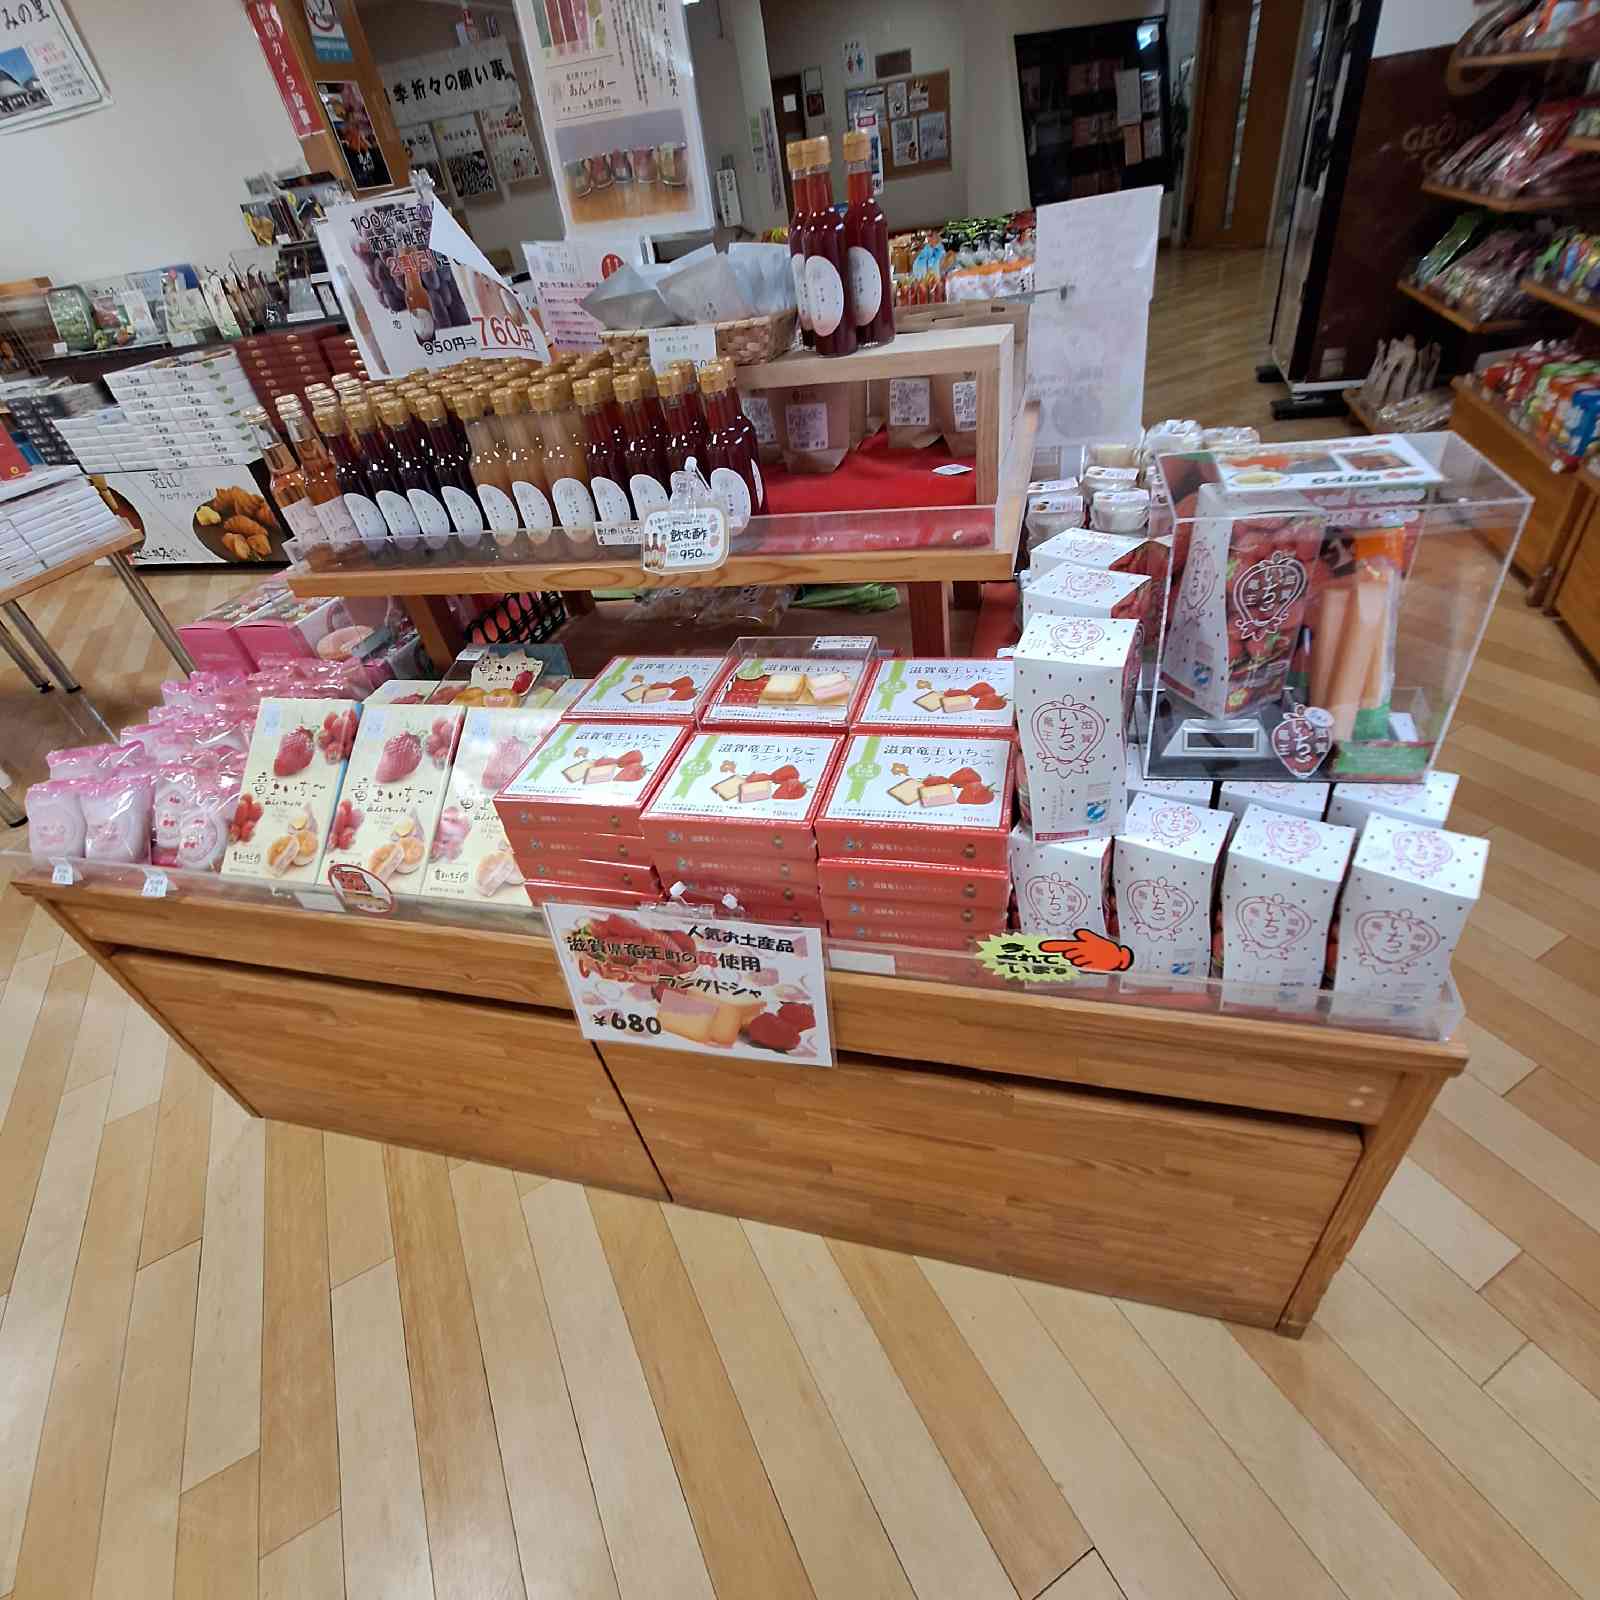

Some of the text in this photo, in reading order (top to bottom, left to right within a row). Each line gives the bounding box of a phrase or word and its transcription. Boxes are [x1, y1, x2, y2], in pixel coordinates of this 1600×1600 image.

[384, 59, 516, 104] 季折々の願い事
[670, 528, 708, 542] 飲む酢
[883, 744, 994, 759] 滋賀竜王いちご
[688, 924, 795, 953] 人気お土産品
[658, 974, 762, 998] ラングドシャ
[593, 1012, 663, 1035] ¥680
